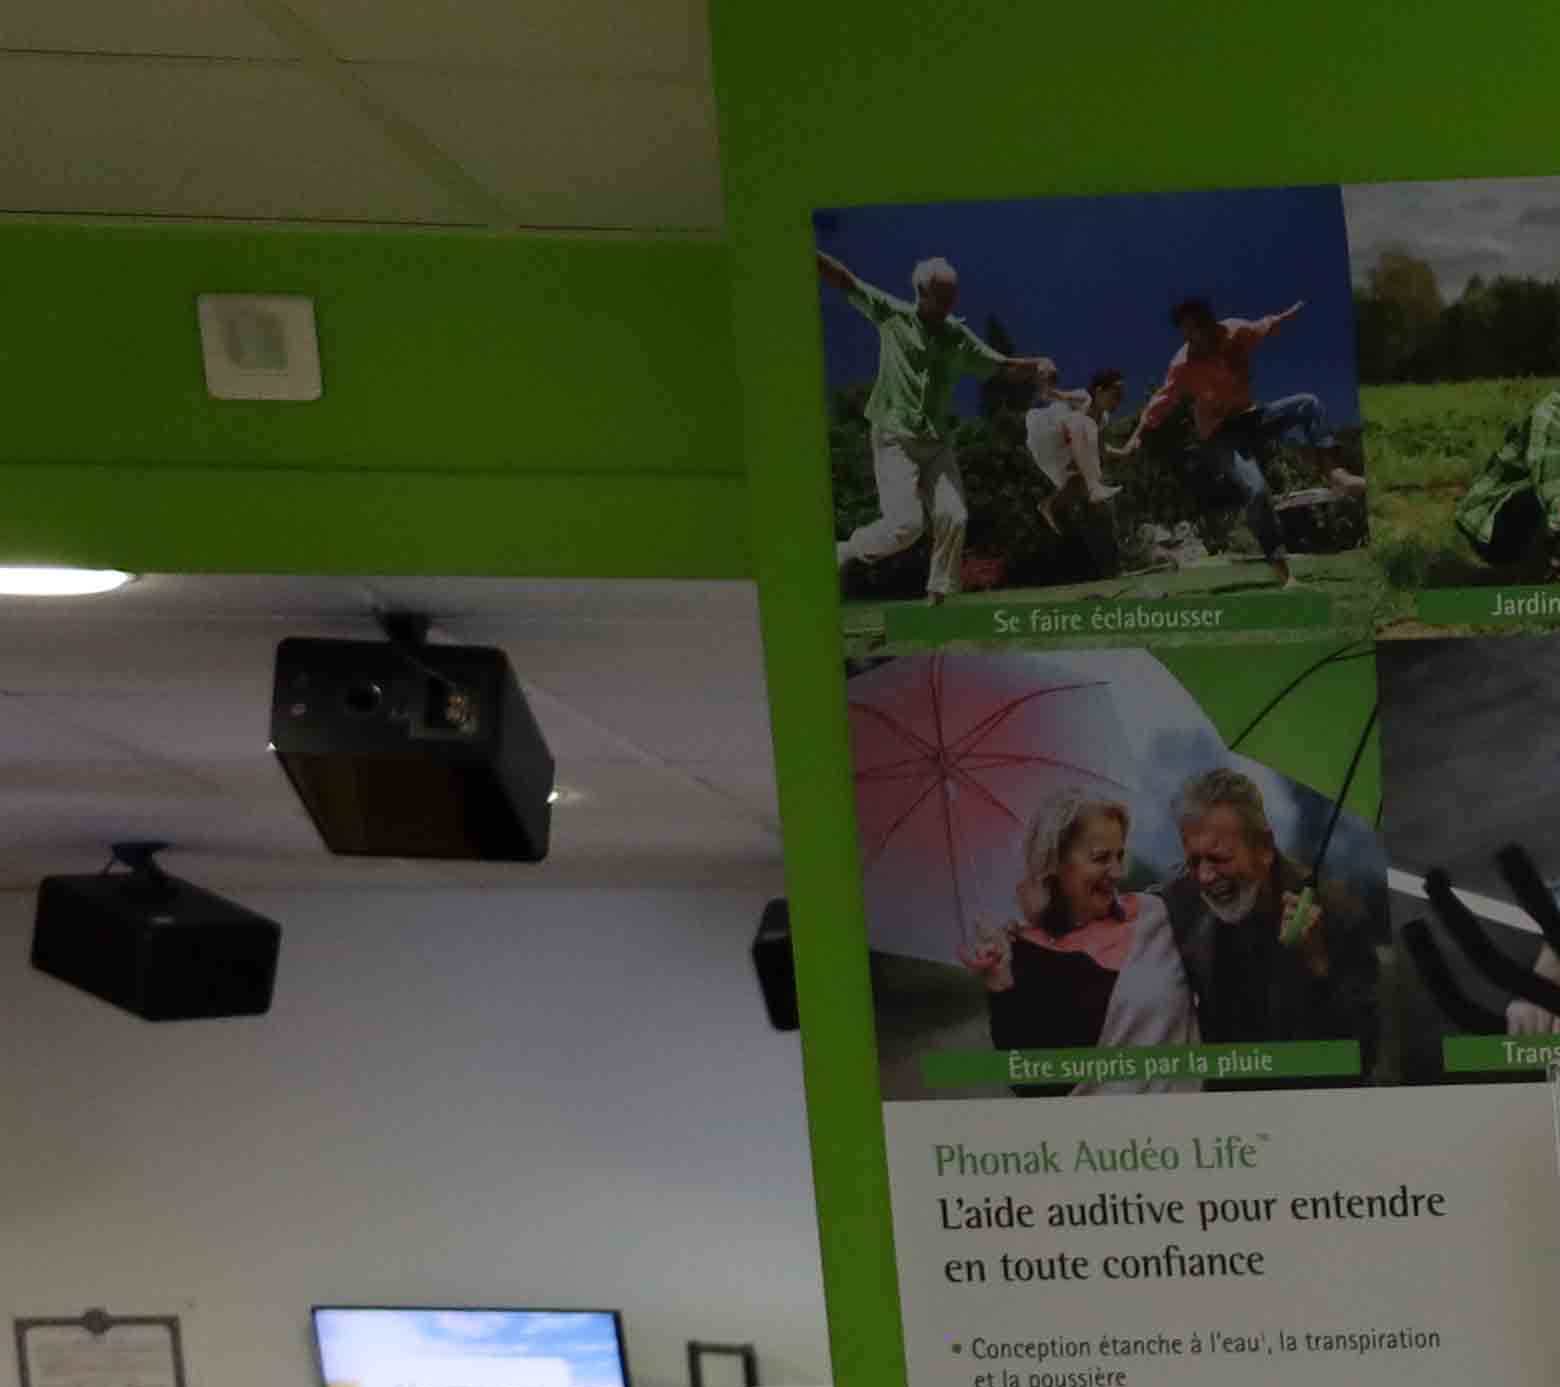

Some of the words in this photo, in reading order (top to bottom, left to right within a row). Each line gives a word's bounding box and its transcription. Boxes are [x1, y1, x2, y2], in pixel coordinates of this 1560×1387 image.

[993, 609, 1020, 632] Se
[1029, 608, 1084, 632] faire
[1091, 605, 1223, 630] éclabousser
[1008, 1050, 1056, 1079] Être
[1061, 1053, 1137, 1081] surpris
[1144, 1056, 1187, 1081] par
[1188, 1052, 1208, 1073] la
[1216, 1049, 1274, 1077] pluie
[934, 1140, 1061, 1177] Phonak
[1073, 1137, 1180, 1174] Audéo
[938, 1195, 1036, 1231] L'aide
[1047, 1191, 1186, 1228] auditive
[1199, 1195, 1280, 1232] pour
[1289, 1184, 1447, 1221] entendre
[943, 1255, 987, 1283] en
[1001, 1250, 1090, 1282] toute
[1102, 1242, 1266, 1279] confiance
[971, 1335, 1092, 1362] Conception
[1098, 1331, 1184, 1358] étanche
[1189, 1331, 1204, 1356] à
[1279, 1328, 1298, 1354] la
[1304, 1326, 1442, 1356] transpiration
